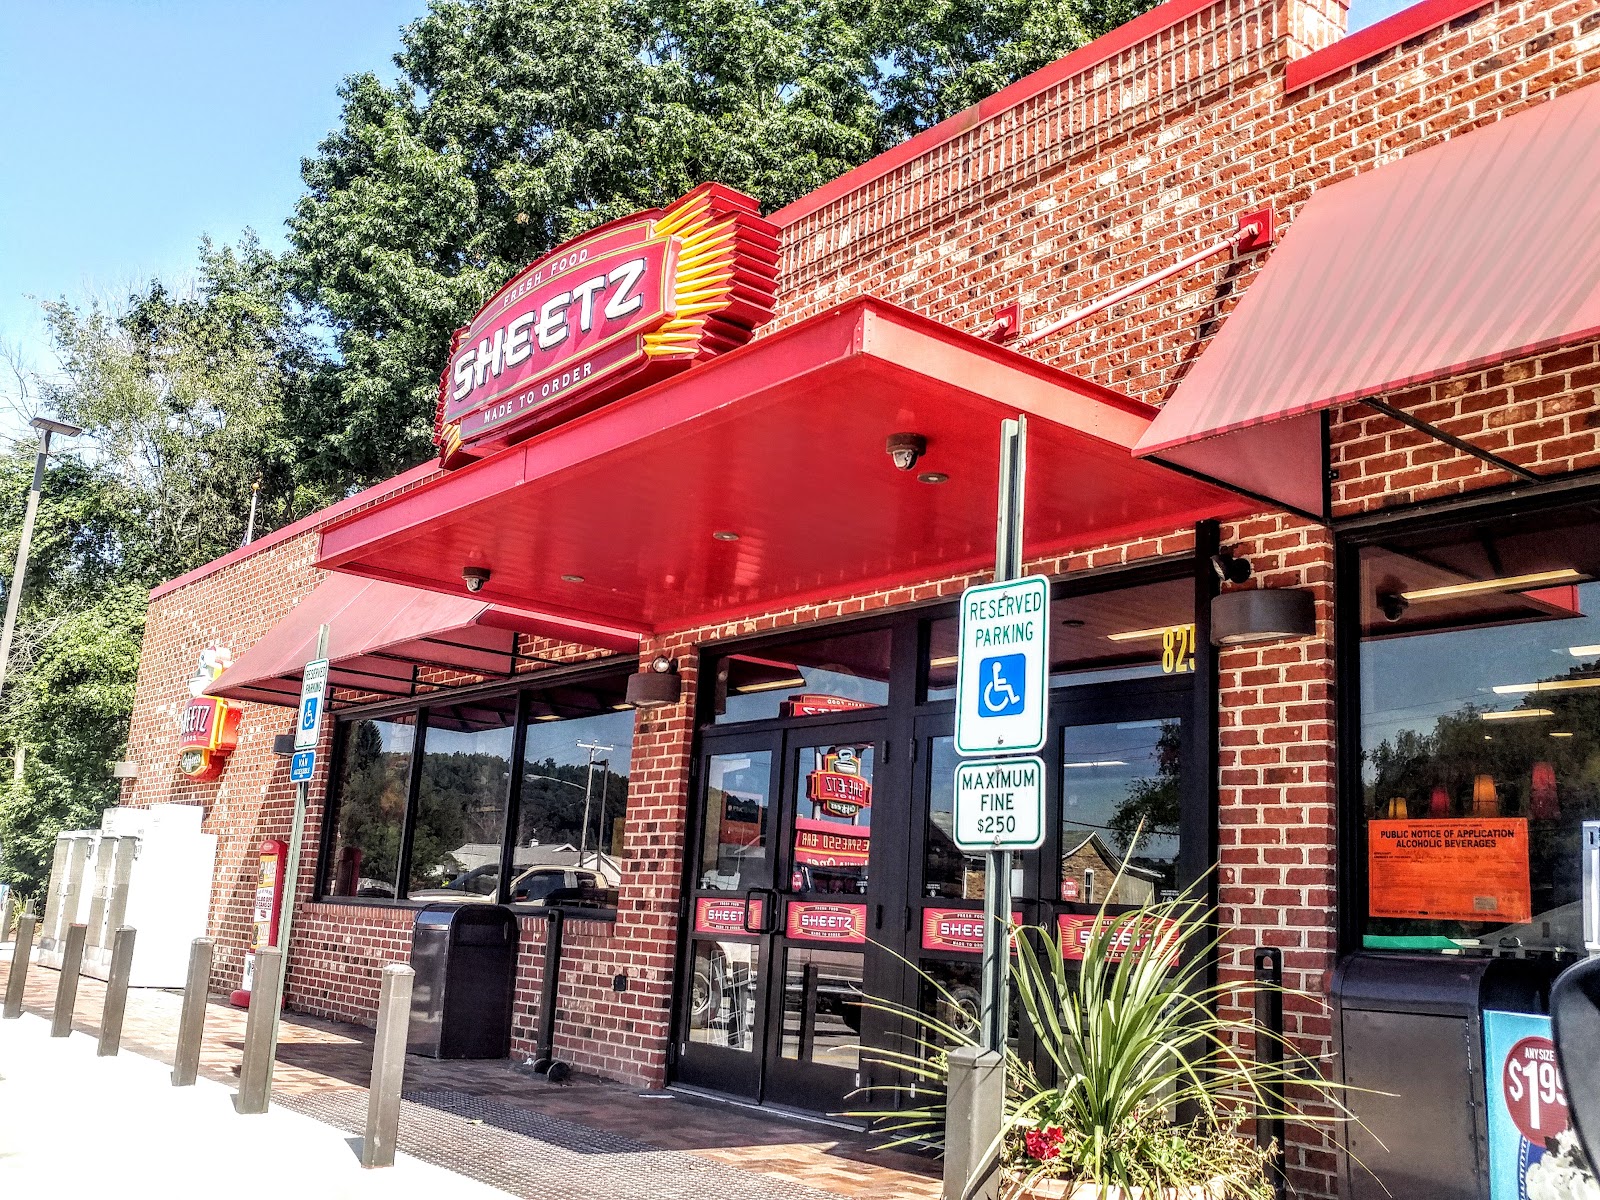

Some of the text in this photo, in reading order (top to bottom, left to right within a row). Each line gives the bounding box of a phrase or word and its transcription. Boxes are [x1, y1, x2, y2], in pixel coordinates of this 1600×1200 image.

[503, 248, 589, 307] FRESH FOOD
[452, 257, 648, 402] SHEETZ
[483, 362, 593, 424] MADE TO ORDER
[969, 591, 1042, 621] RESERVED
[975, 620, 1034, 648] PARKING
[180, 705, 211, 735] HEETZ
[962, 768, 1035, 791] MAXIMUM
[980, 793, 1015, 812] FINE
[977, 815, 1016, 835] $250
[1380, 828, 1515, 838] PUBLIC NOTICE OF APPLICATION
[1395, 839, 1497, 848] ALCOHOLIC BEVERAGES
[708, 909, 750, 922] SHEET
[801, 914, 852, 928] SHEETZ
[941, 922, 984, 937] SHEE
[1525, 1047, 1555, 1062] ANY SIZE
